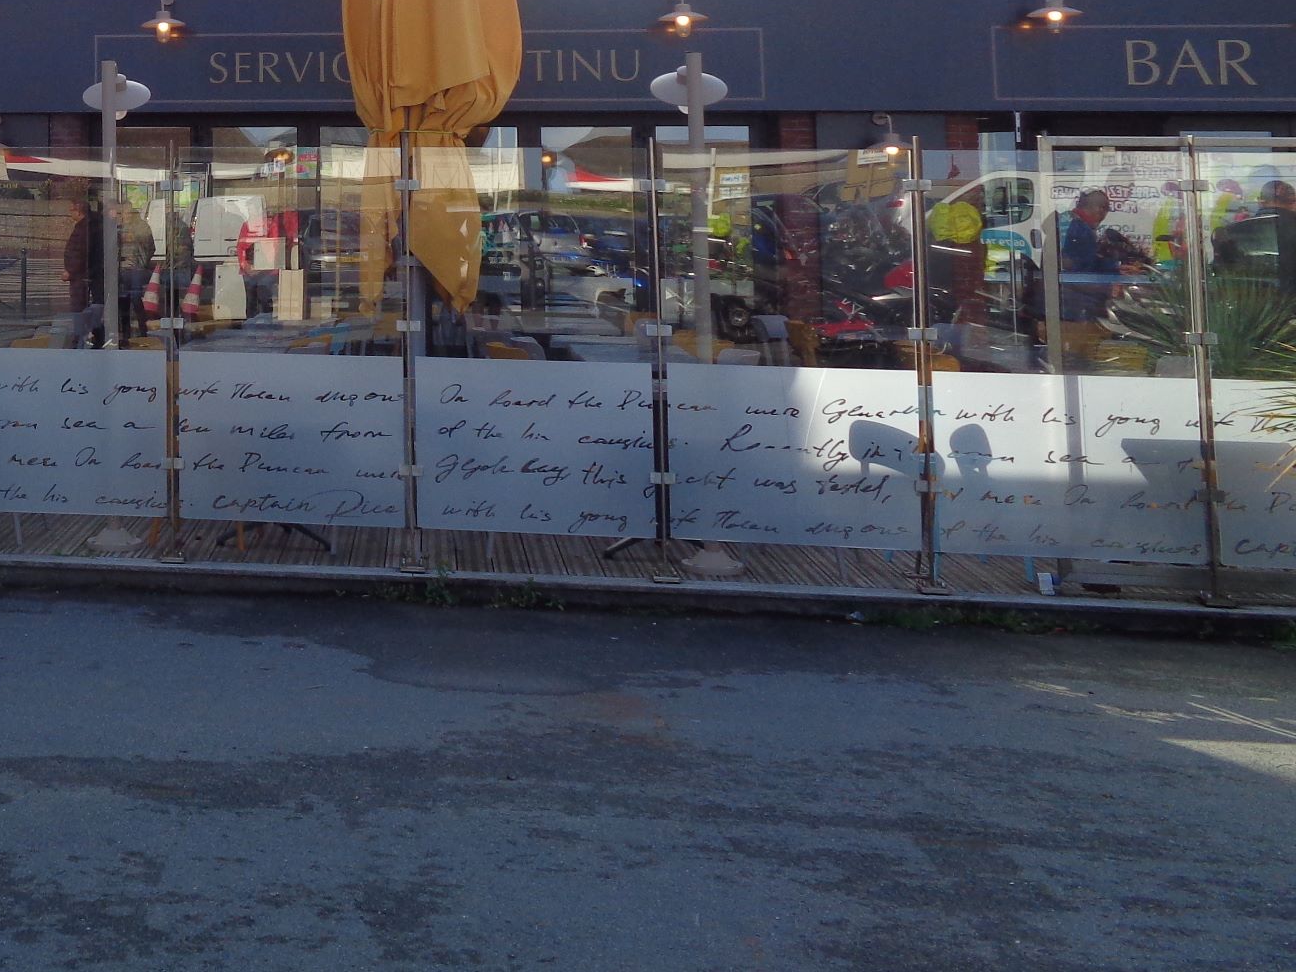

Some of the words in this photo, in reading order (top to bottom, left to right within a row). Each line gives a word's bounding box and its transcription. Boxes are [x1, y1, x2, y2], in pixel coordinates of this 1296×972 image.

[209, 51, 352, 84] SERVIC
[527, 49, 641, 82] TINU
[1124, 39, 1258, 87] BAR
